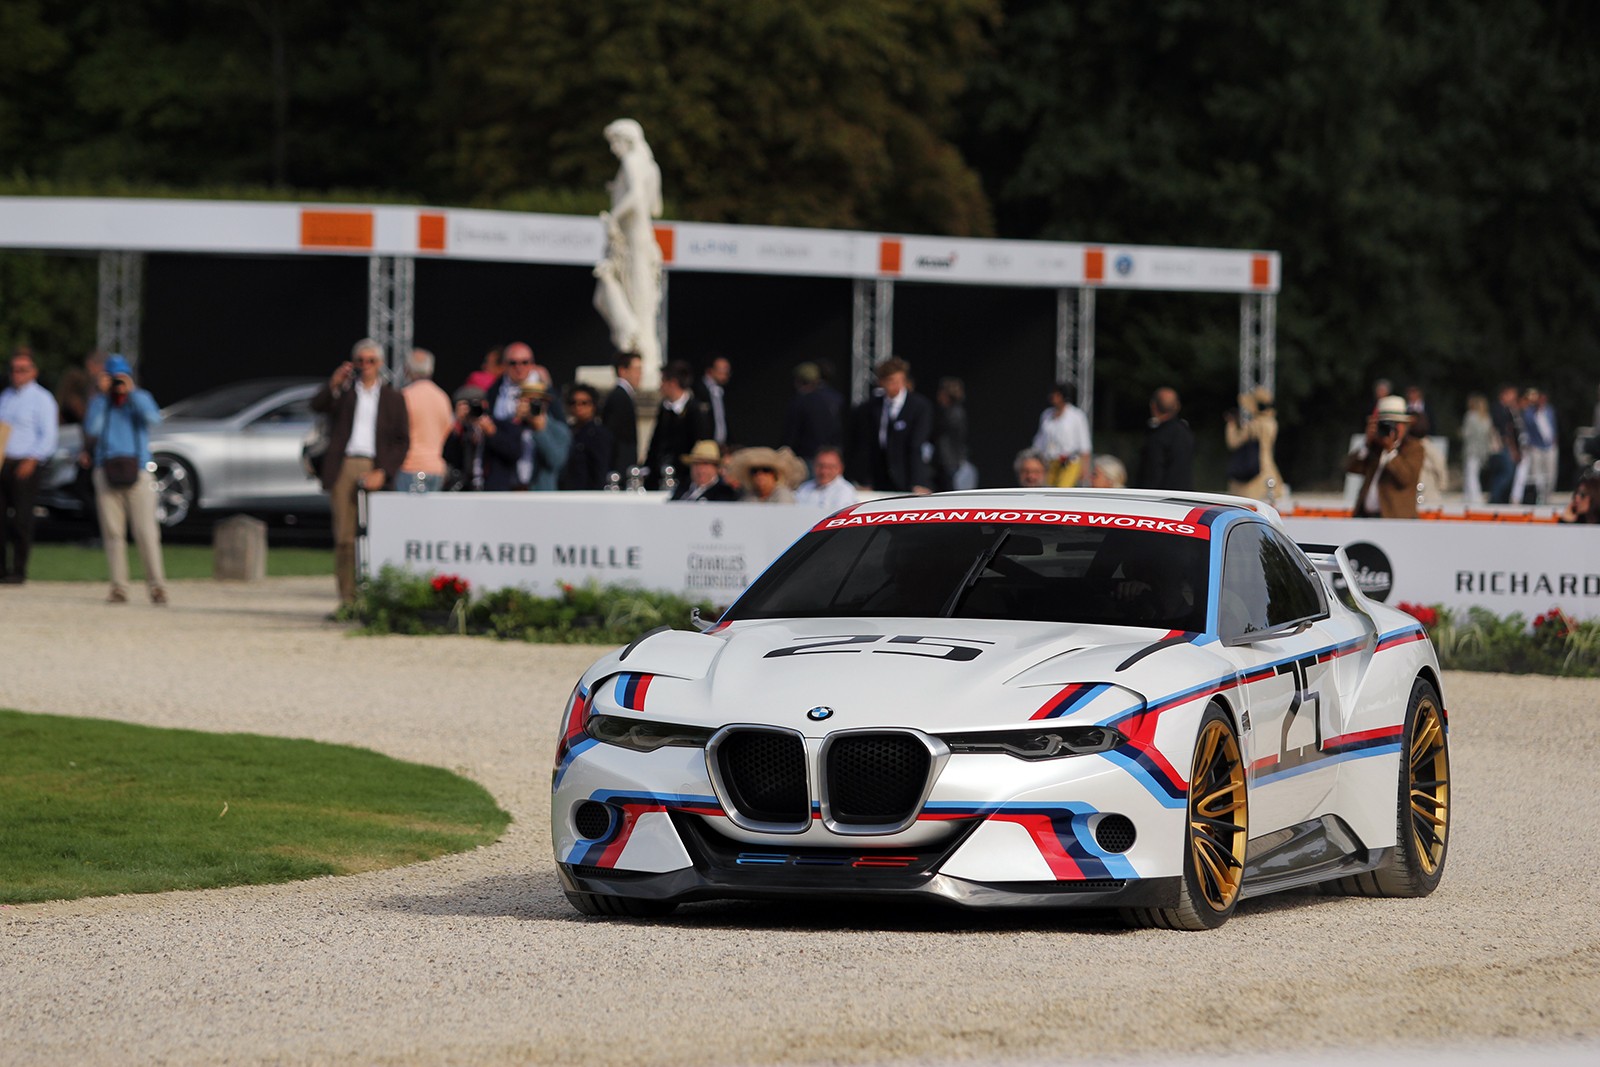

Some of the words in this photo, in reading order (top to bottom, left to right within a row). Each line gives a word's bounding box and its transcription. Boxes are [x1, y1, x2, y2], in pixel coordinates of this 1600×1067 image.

[825, 511, 959, 528] BAVARIAN
[972, 510, 1081, 524] MOTOR
[1088, 515, 1196, 535] WORKS
[405, 540, 537, 566] RICHARD
[554, 544, 643, 570] MILLE
[1455, 570, 1600, 597] RICHARD
[763, 634, 996, 662] 25
